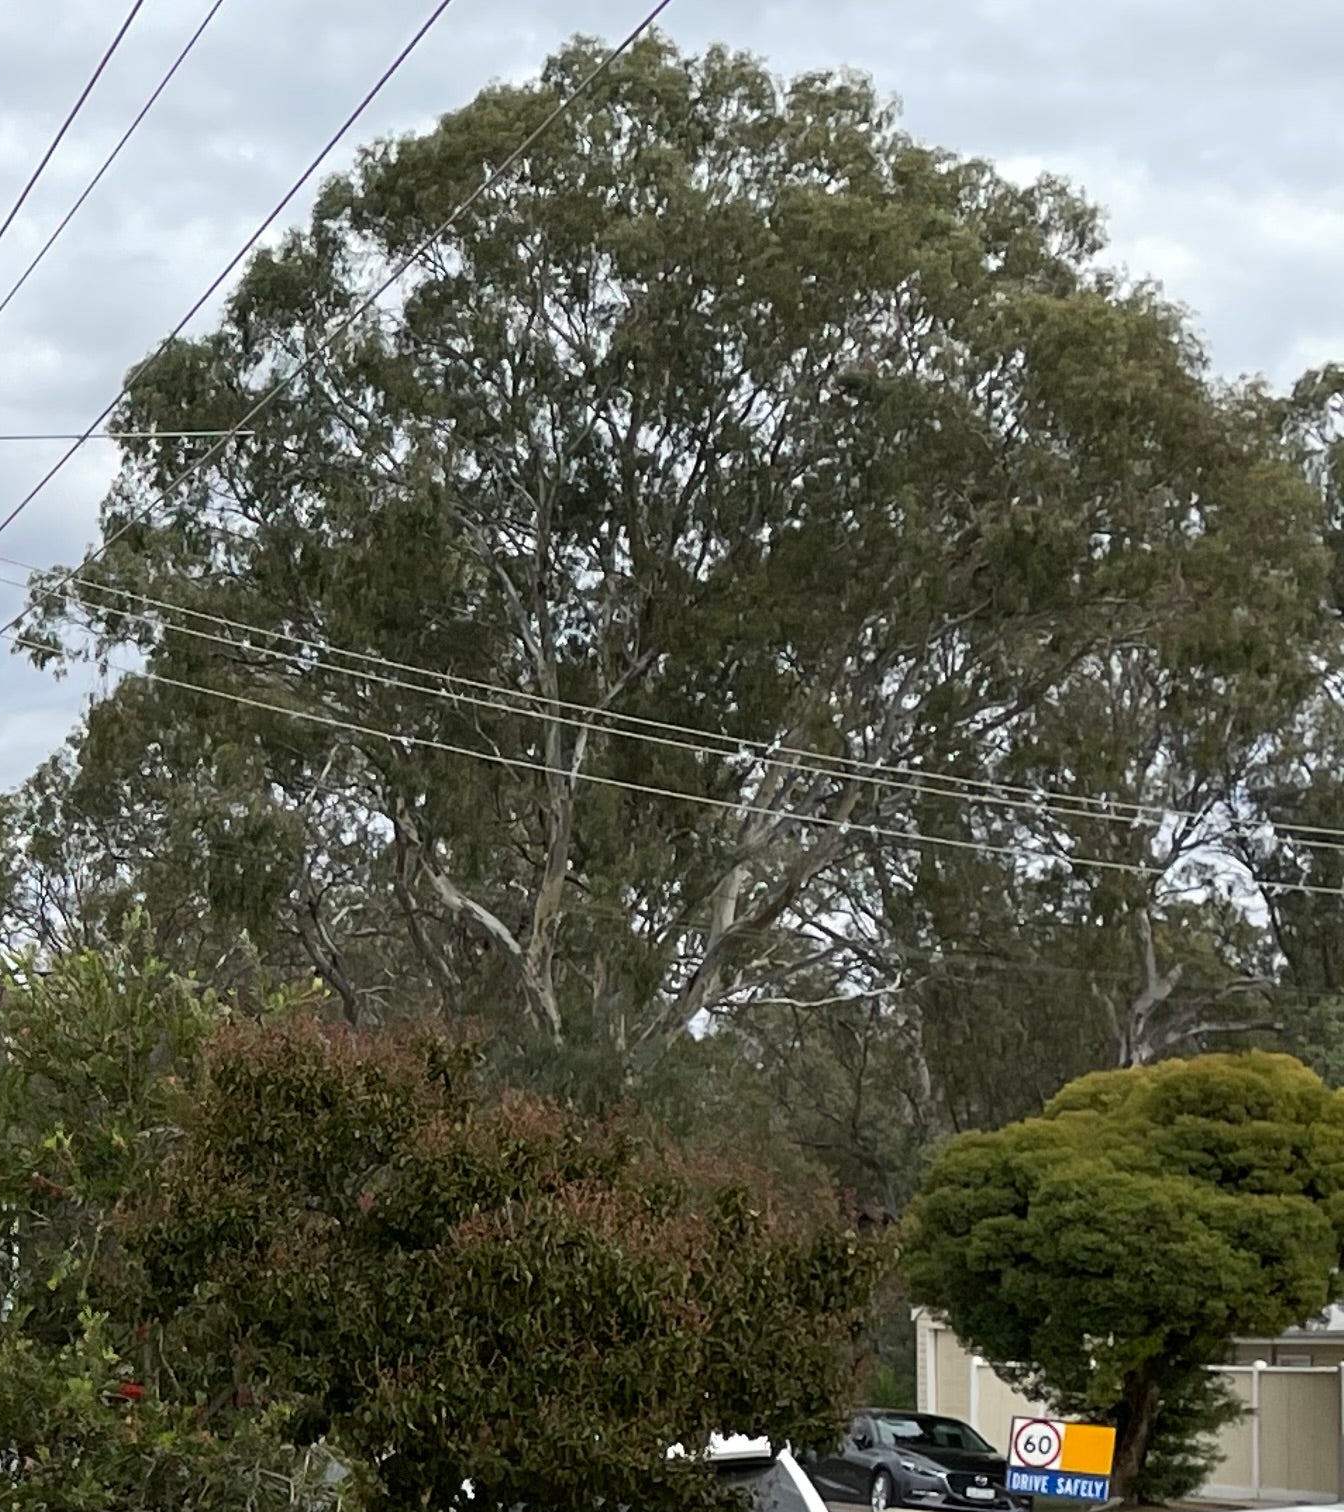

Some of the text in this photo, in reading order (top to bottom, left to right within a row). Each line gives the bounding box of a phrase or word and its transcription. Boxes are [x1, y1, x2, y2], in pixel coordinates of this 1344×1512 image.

[1023, 1435, 1052, 1455] 60
[1012, 1473, 1049, 1494] DRIVE
[1055, 1477, 1103, 1499] SAFELY
